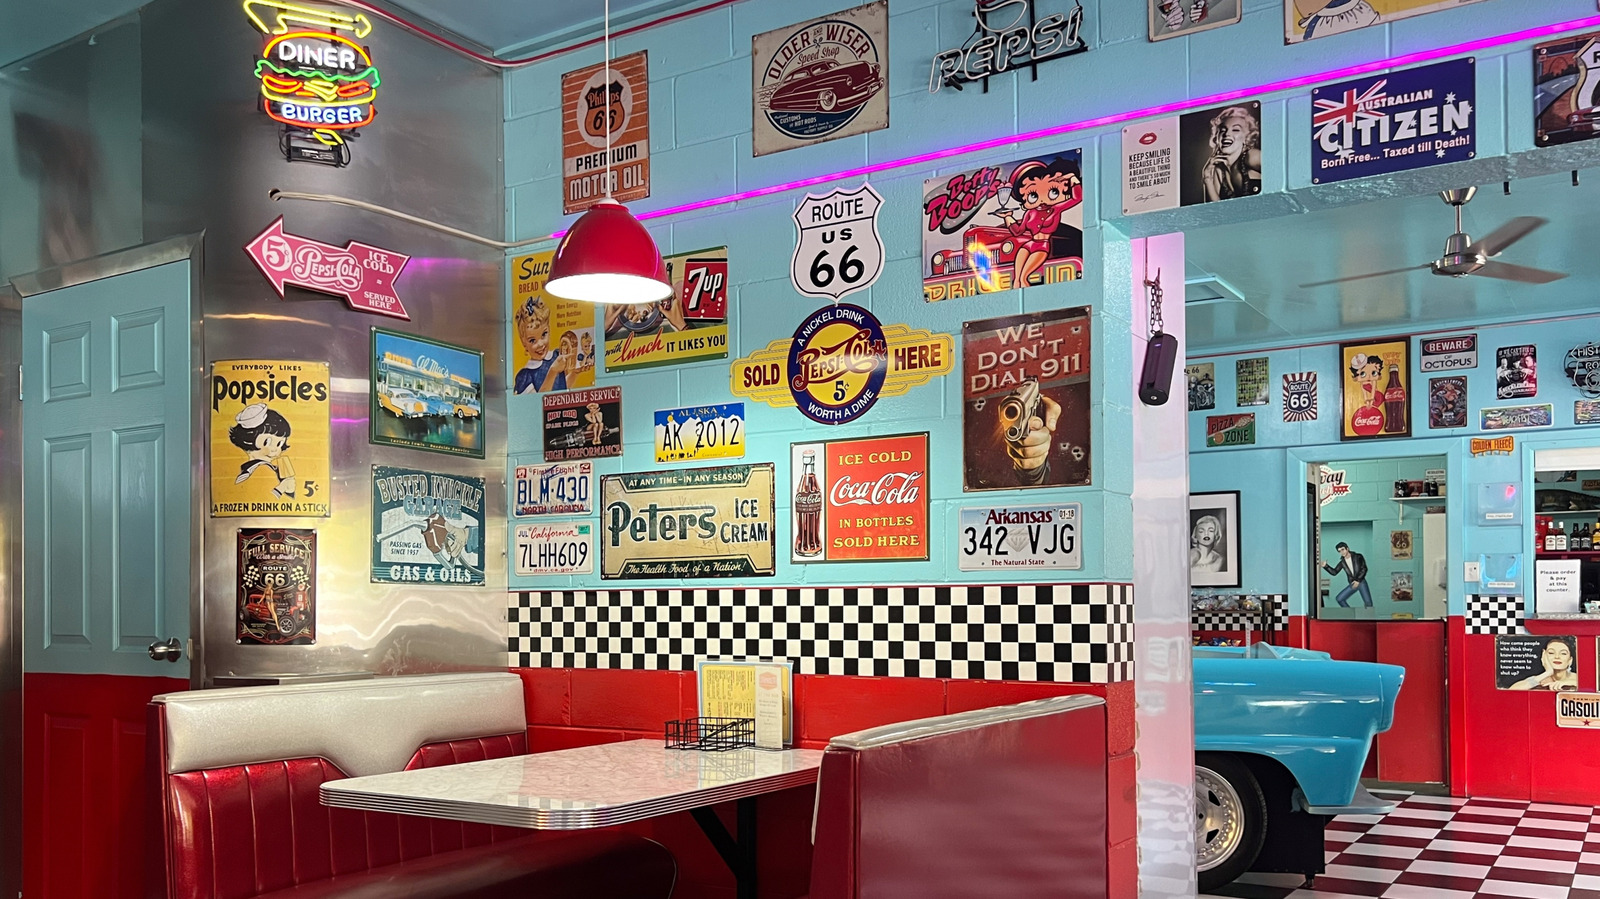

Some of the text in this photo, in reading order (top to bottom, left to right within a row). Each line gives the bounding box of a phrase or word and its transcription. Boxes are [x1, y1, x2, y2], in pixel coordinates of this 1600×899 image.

[279, 41, 356, 70] DINER
[768, 24, 870, 80] OLDER WISER
[798, 47, 840, 66] Speed Shop
[928, 6, 1081, 94] PEPSI
[1357, 90, 1433, 112] AUSTRALIAN
[281, 104, 362, 124] BURGER
[593, 109, 617, 130] 66
[1320, 101, 1469, 153] CITIZEN
[576, 144, 637, 172] PREMIUM
[1129, 148, 1170, 162] KEEP SMILING
[1322, 135, 1470, 169] Born Free... Taxed till Death!
[1129, 160, 1153, 170] BECAUSE
[570, 164, 645, 201] MOTOR OIL
[948, 167, 1000, 200] Betty
[1137, 180, 1152, 189] SMILE
[1153, 176, 1170, 186] ABOUT
[812, 198, 864, 223] ROUTE
[363, 258, 395, 275] COLD
[368, 250, 389, 265] ICE
[810, 245, 865, 288] 66
[519, 282, 539, 294] BREAD
[364, 292, 396, 305] SERVED
[369, 300, 392, 310] HERE
[798, 309, 865, 347] A NICKEL DRINK
[996, 322, 1045, 346] WE
[605, 327, 726, 363] with lunch IT LIKES YOU
[1430, 340, 1468, 352] BEWARE
[894, 344, 941, 372] HERE
[978, 338, 1064, 372] DON'T
[1425, 358, 1472, 369] OCTOPUS
[743, 364, 781, 388] SOLD
[971, 353, 1082, 393] DIAL 911
[544, 389, 620, 407] DEPENDABLE SERVICE
[808, 390, 875, 420] WORTH A DIME
[1290, 394, 1309, 409] 66
[663, 418, 740, 451] AK 2012
[1212, 418, 1234, 434] PIZZA
[1225, 430, 1249, 443] ZONE
[1473, 440, 1512, 450] GOLDEN FLEECE
[546, 445, 621, 460] HIGH PERFORMANCE
[838, 451, 912, 466] ICE COLD
[629, 472, 744, 488] AT ANY ANY SEASON
[830, 471, 924, 507] Coca-Cola
[377, 475, 482, 512] BUSTED KNUCKLE
[213, 502, 327, 513] A FROZEN DRINK ON A STICK
[403, 494, 462, 520] GARAGE
[735, 498, 759, 519] ICE
[1060, 510, 1075, 518] 01-18
[607, 501, 717, 547] Peters
[839, 515, 914, 529] IN BOTTLES
[985, 509, 1053, 525] Arkansas
[530, 527, 579, 542] California
[720, 522, 768, 544] CREAM
[833, 535, 920, 548] SOLD HERE
[964, 526, 1009, 556] 342
[248, 544, 305, 560] FULL SERVICE
[390, 541, 412, 549] PASSING
[520, 542, 588, 568] 7LHH609
[390, 565, 472, 583] GAS & OILS
[625, 564, 640, 575] The
[641, 564, 667, 575] Health
[668, 563, 688, 575] Food
[692, 564, 702, 576] of
[713, 560, 747, 572] Nation!
[265, 573, 286, 587] 66
